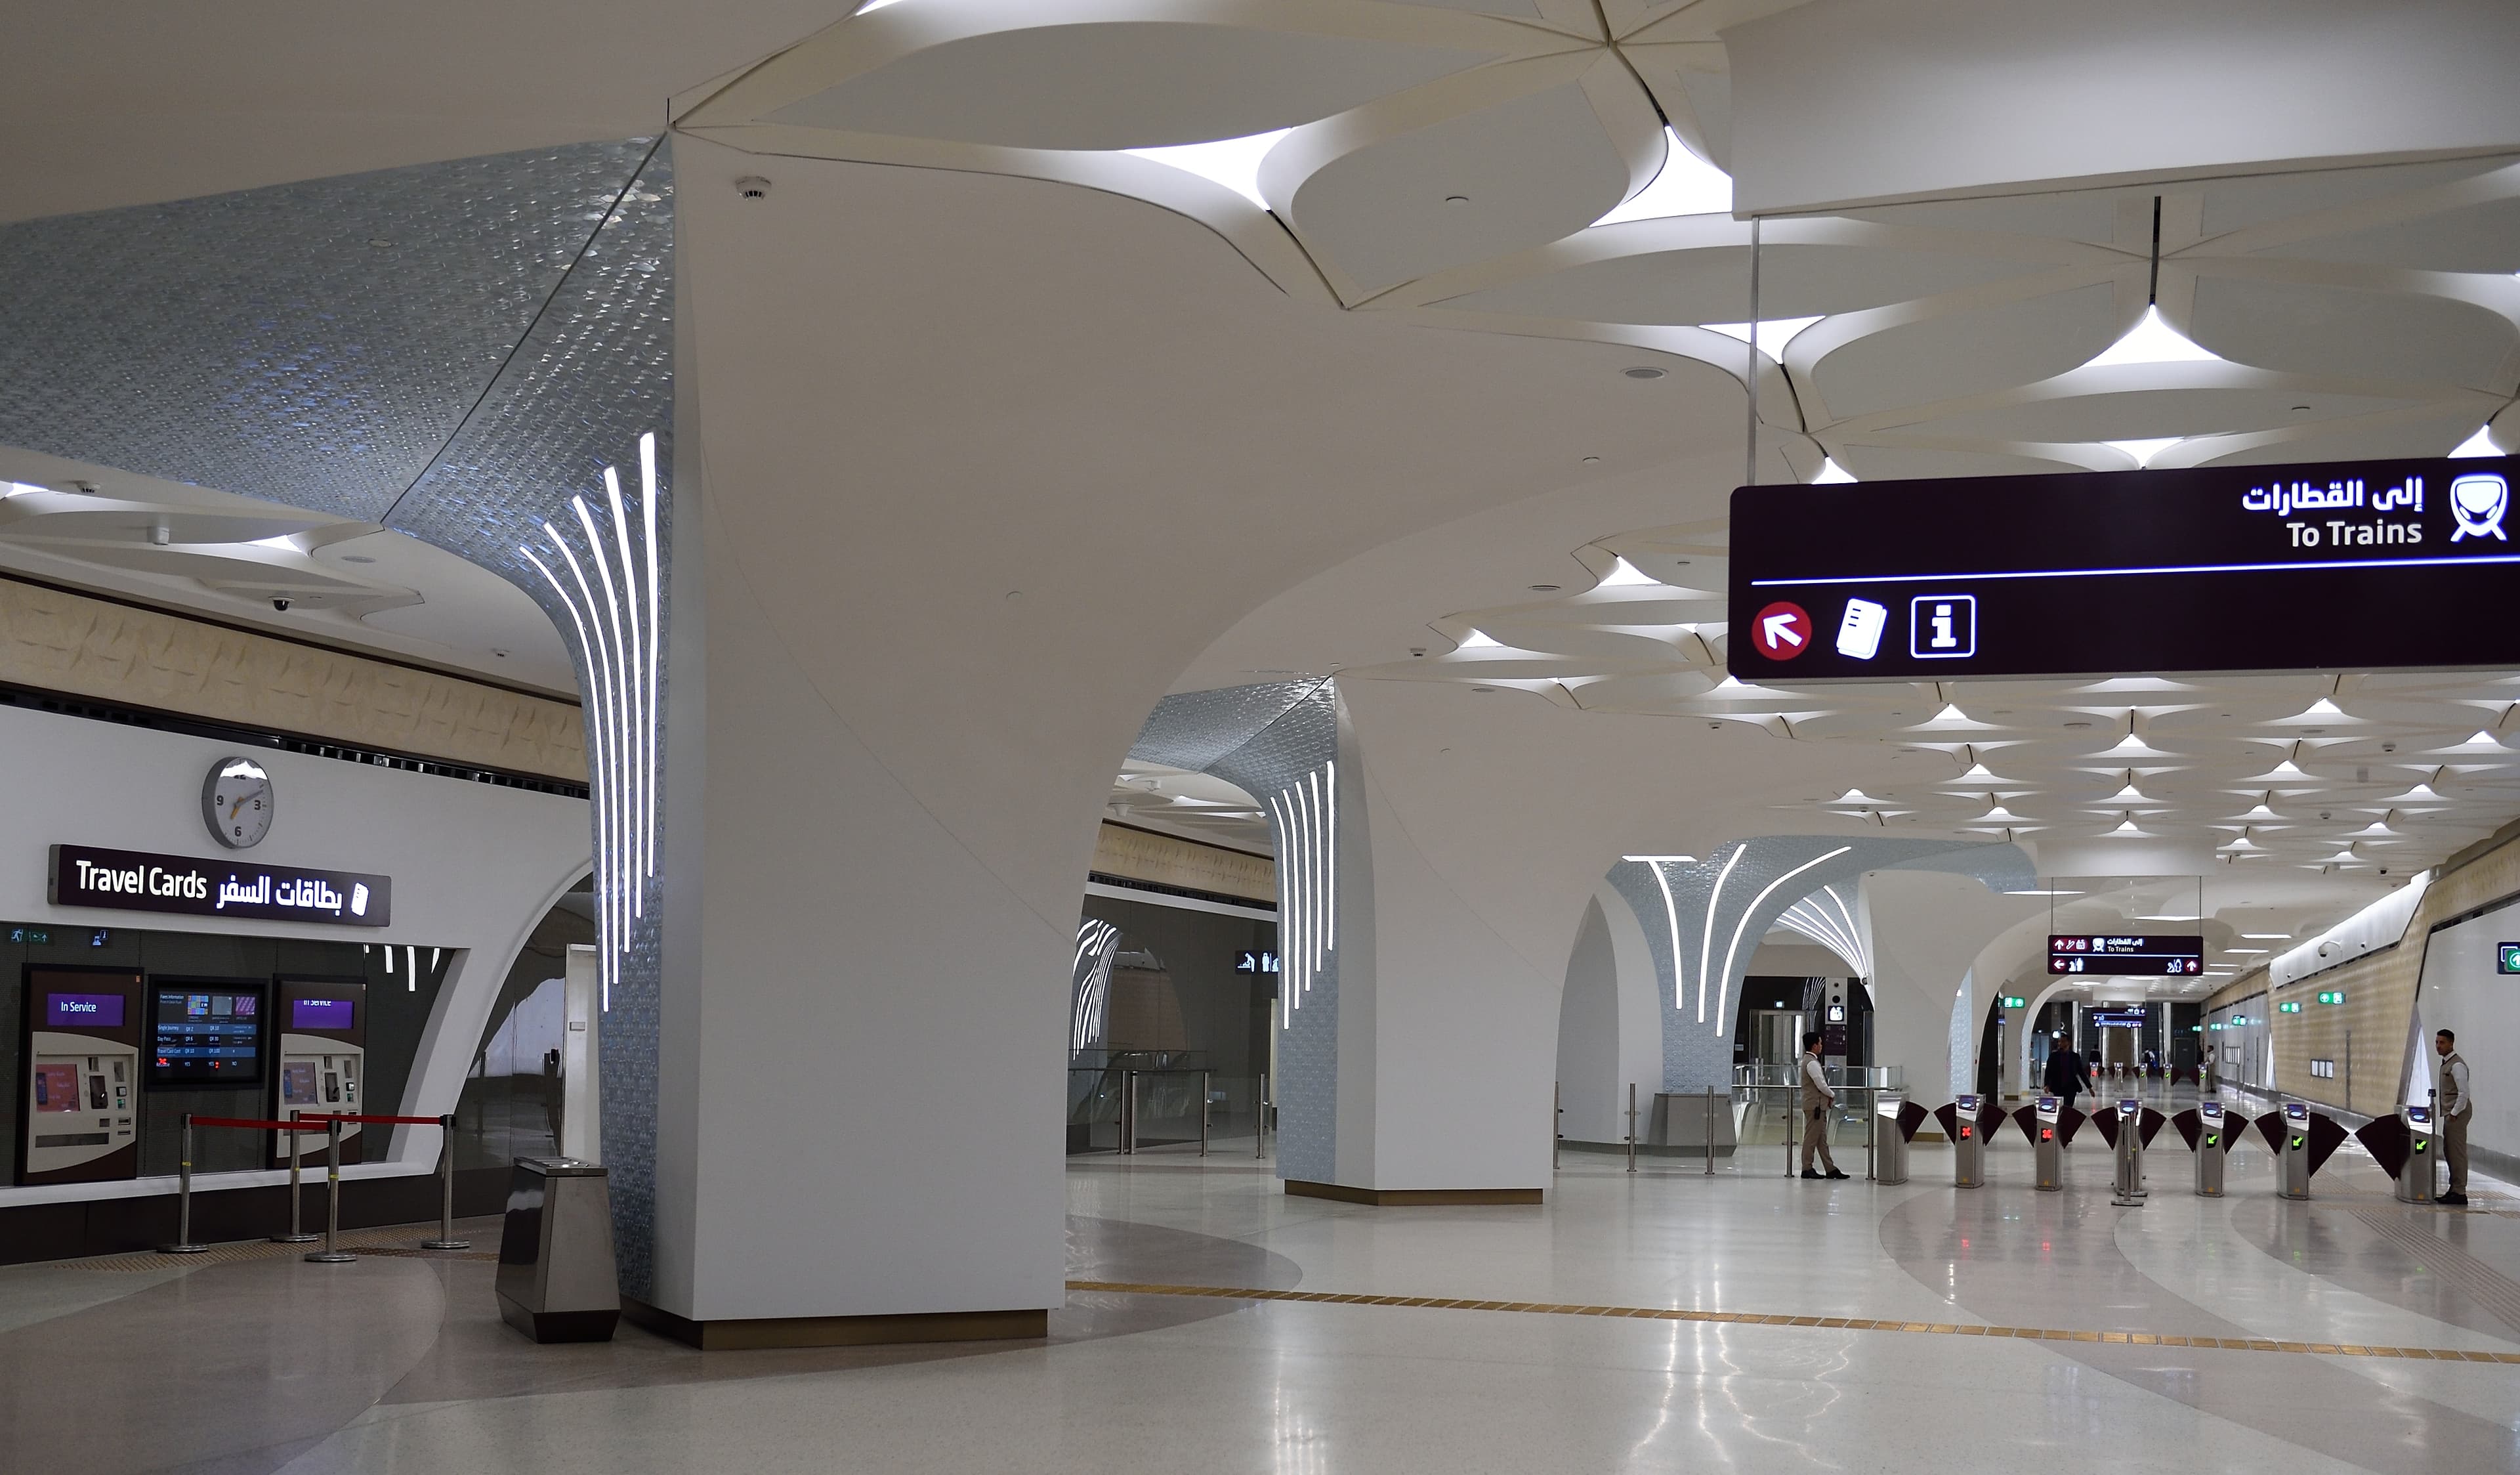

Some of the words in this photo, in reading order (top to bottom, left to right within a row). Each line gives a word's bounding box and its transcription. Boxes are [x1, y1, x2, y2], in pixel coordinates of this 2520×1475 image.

[2242, 479, 2363, 517] القطارات
[2372, 476, 2423, 512] إلى
[2286, 522, 2320, 547] To
[2326, 519, 2422, 546] Trains
[217, 795, 224, 806] 9
[254, 800, 261, 811] 3
[234, 826, 242, 837] 6
[76, 860, 144, 894] Travel
[148, 866, 207, 899] Cards
[216, 874, 271, 909] السفر
[275, 878, 343, 916] بطاقات
[2132, 938, 2143, 947] إلى
[61, 1001, 68, 1012] In
[70, 1001, 96, 1012] Service
